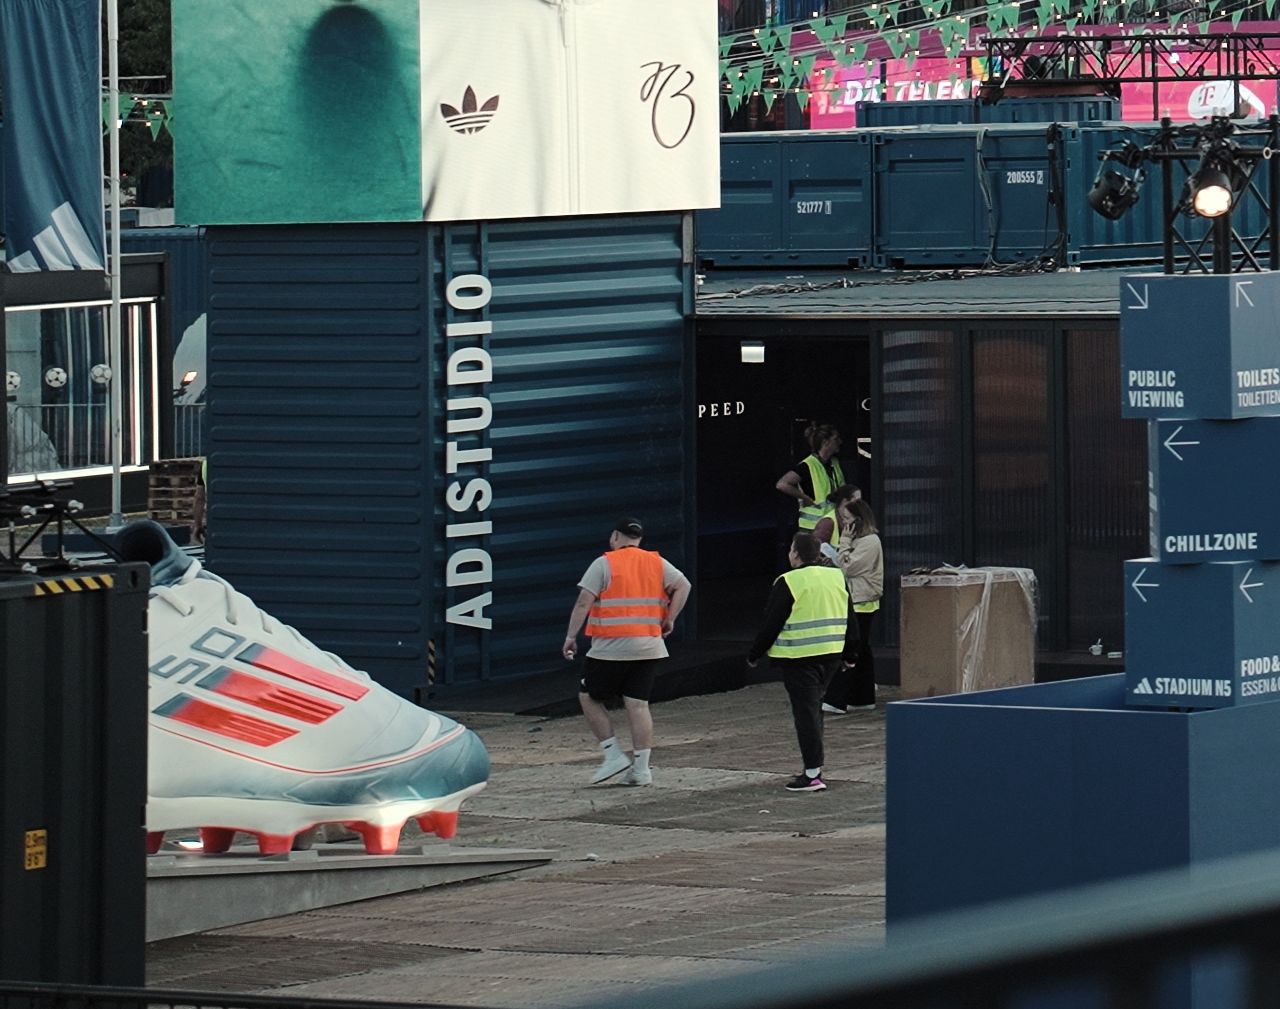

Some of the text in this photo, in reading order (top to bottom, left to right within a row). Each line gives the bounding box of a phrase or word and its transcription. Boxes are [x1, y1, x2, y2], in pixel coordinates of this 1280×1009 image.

[1006, 170, 1036, 184] 200555
[796, 200, 824, 214] 521777
[1128, 370, 1177, 388] PUBLIC
[1237, 367, 1280, 387] TOILETS
[698, 400, 745, 418] PEED
[1128, 391, 1185, 409] VIEWING
[446, 273, 494, 632] ADISTUDIO
[1165, 532, 1258, 553] CHILLZONE
[1154, 678, 1232, 697] STADIUM N5
